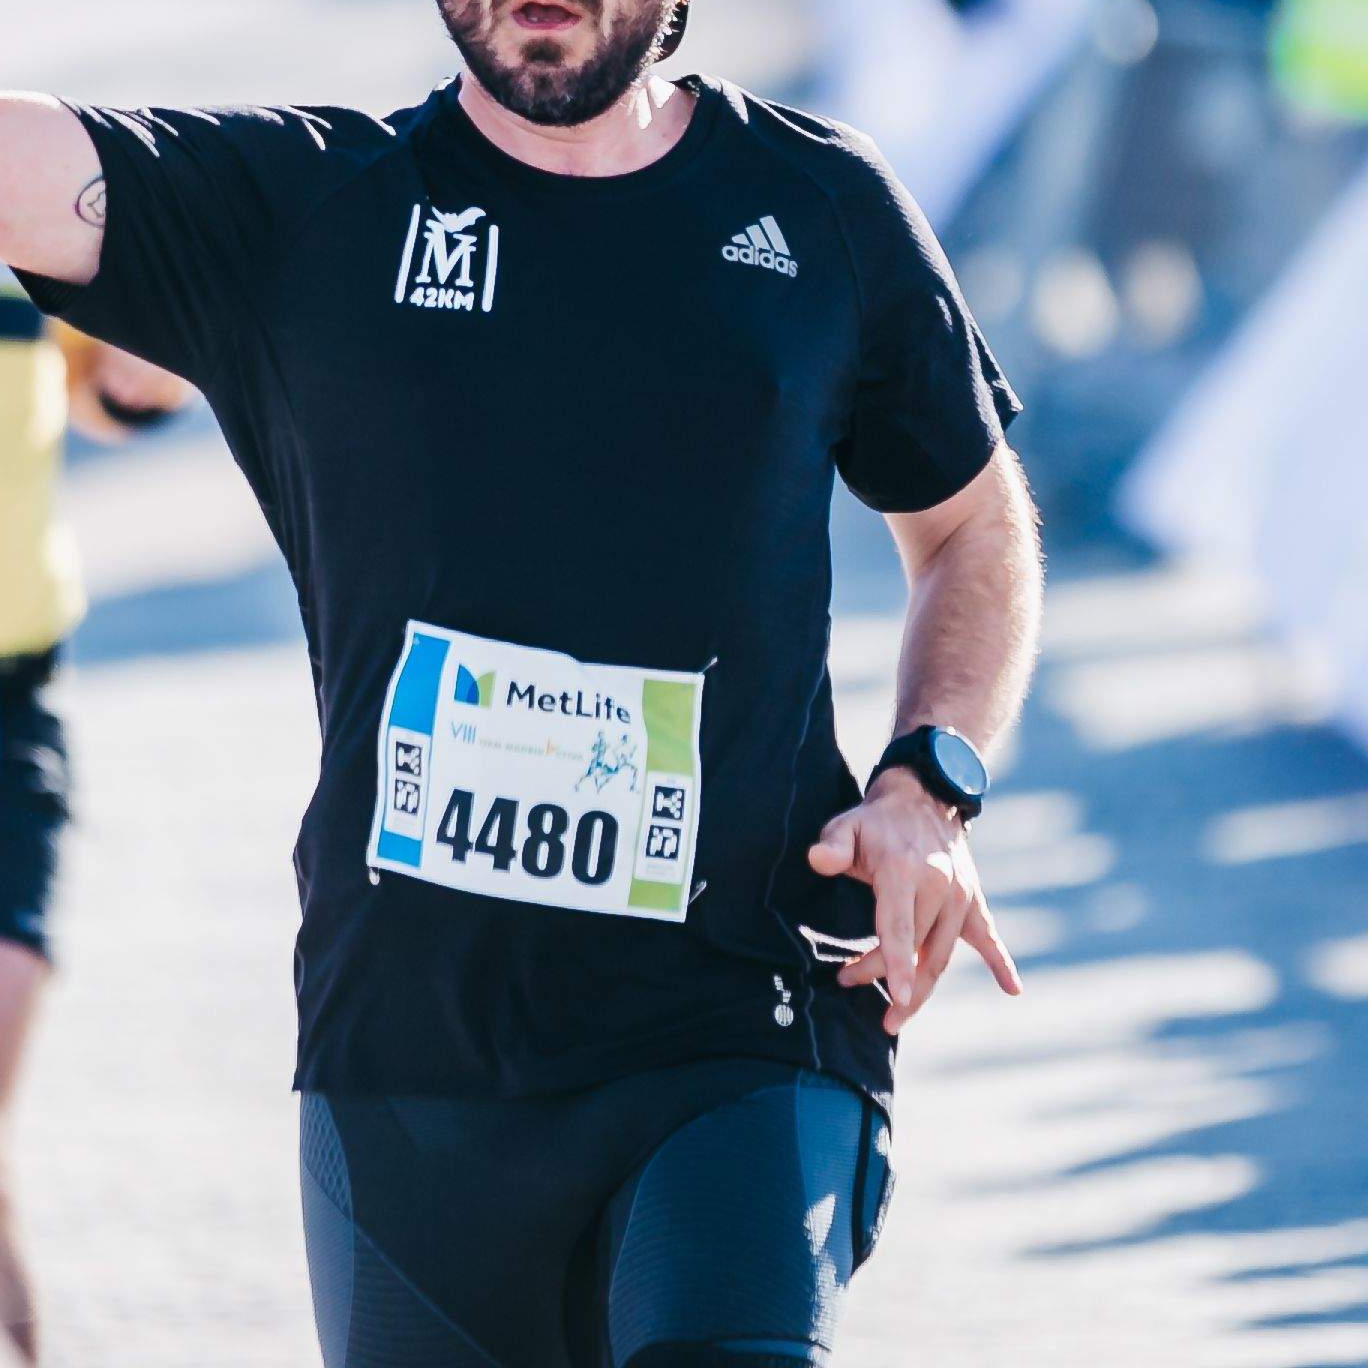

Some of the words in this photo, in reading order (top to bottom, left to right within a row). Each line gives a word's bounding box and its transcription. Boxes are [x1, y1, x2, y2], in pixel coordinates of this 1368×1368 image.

[722, 245, 798, 278] adidas
[410, 287, 475, 311] 42KM
[506, 681, 632, 725] MetLife
[436, 788, 620, 888] 4480
